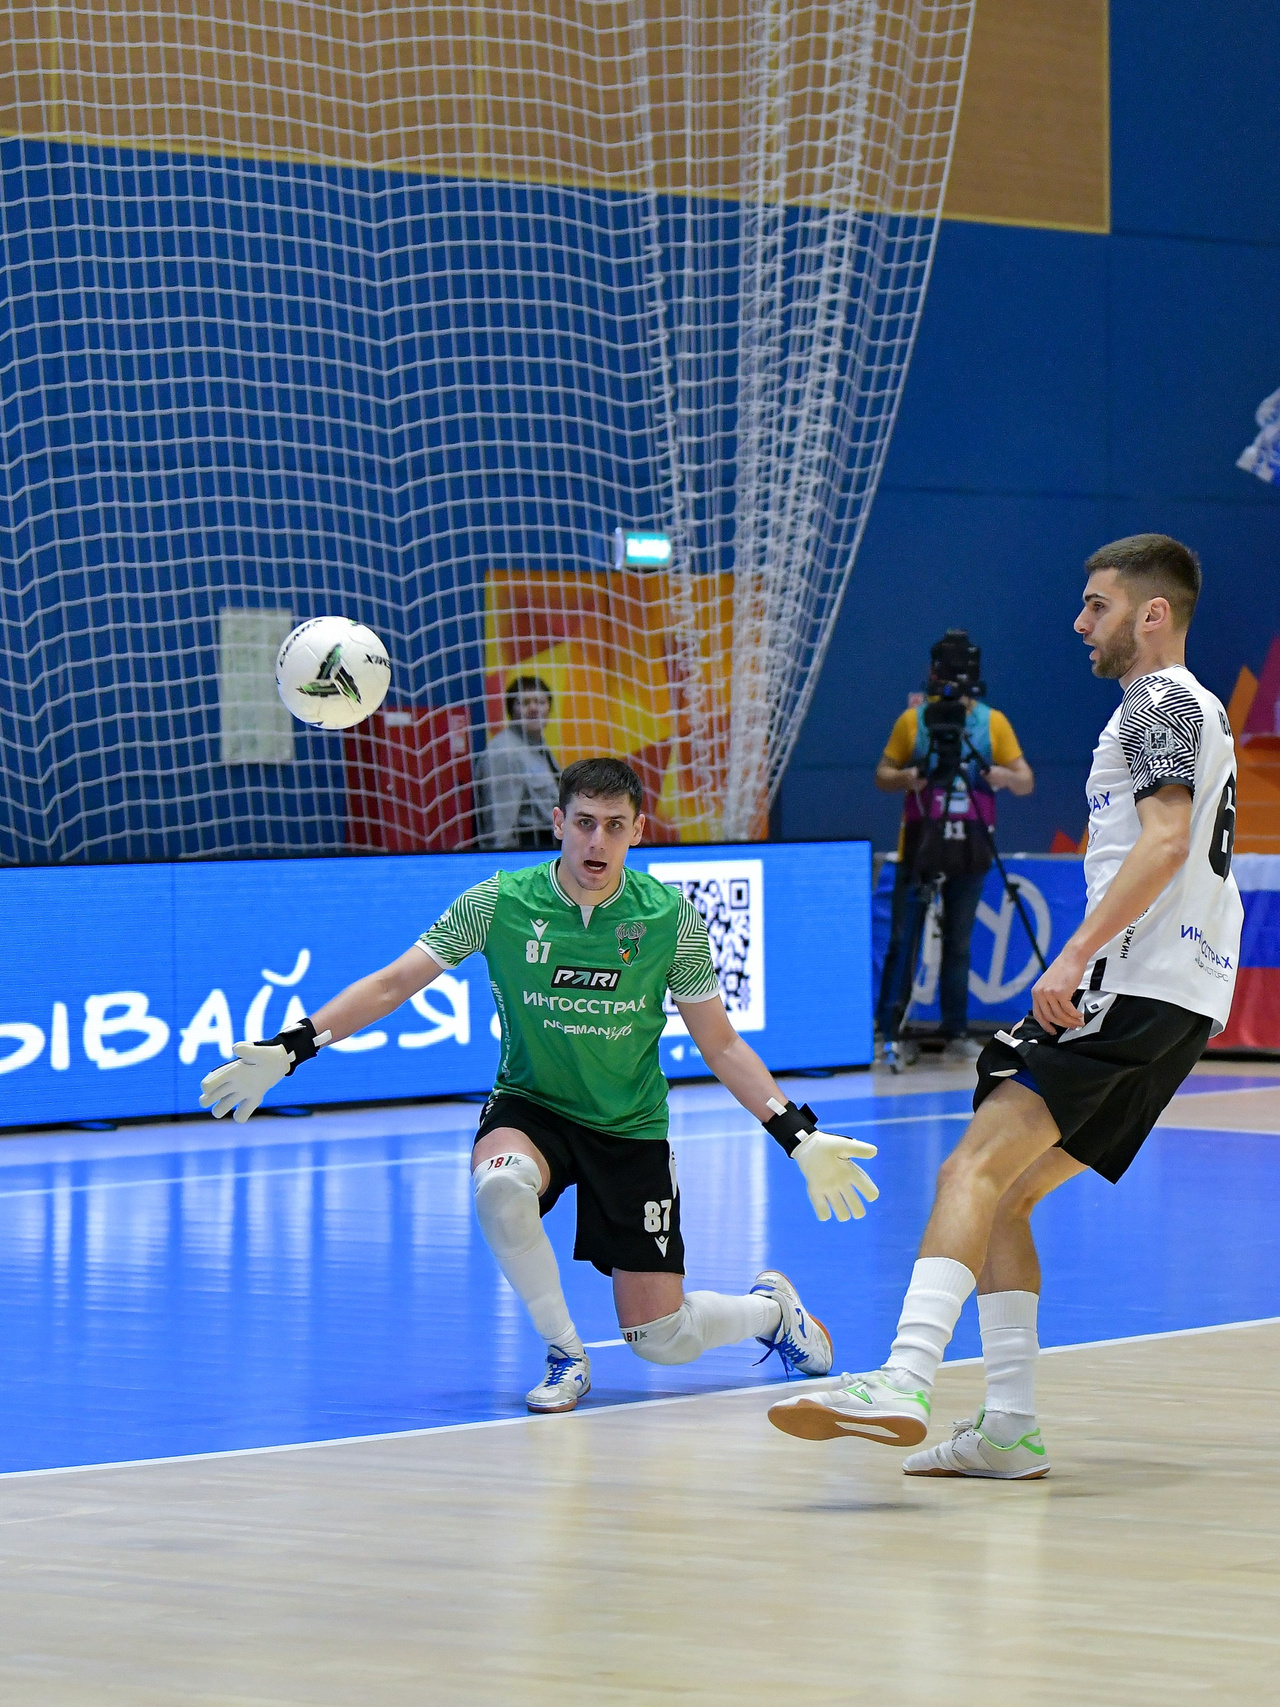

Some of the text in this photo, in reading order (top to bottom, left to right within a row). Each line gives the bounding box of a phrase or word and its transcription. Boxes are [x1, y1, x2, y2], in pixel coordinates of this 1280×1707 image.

[1148, 757, 1174, 770] 1221
[525, 939, 552, 964] 87
[554, 969, 618, 988] PARI
[522, 990, 647, 1015] ИНГОССТРАХ
[643, 1199, 672, 1233] 87
